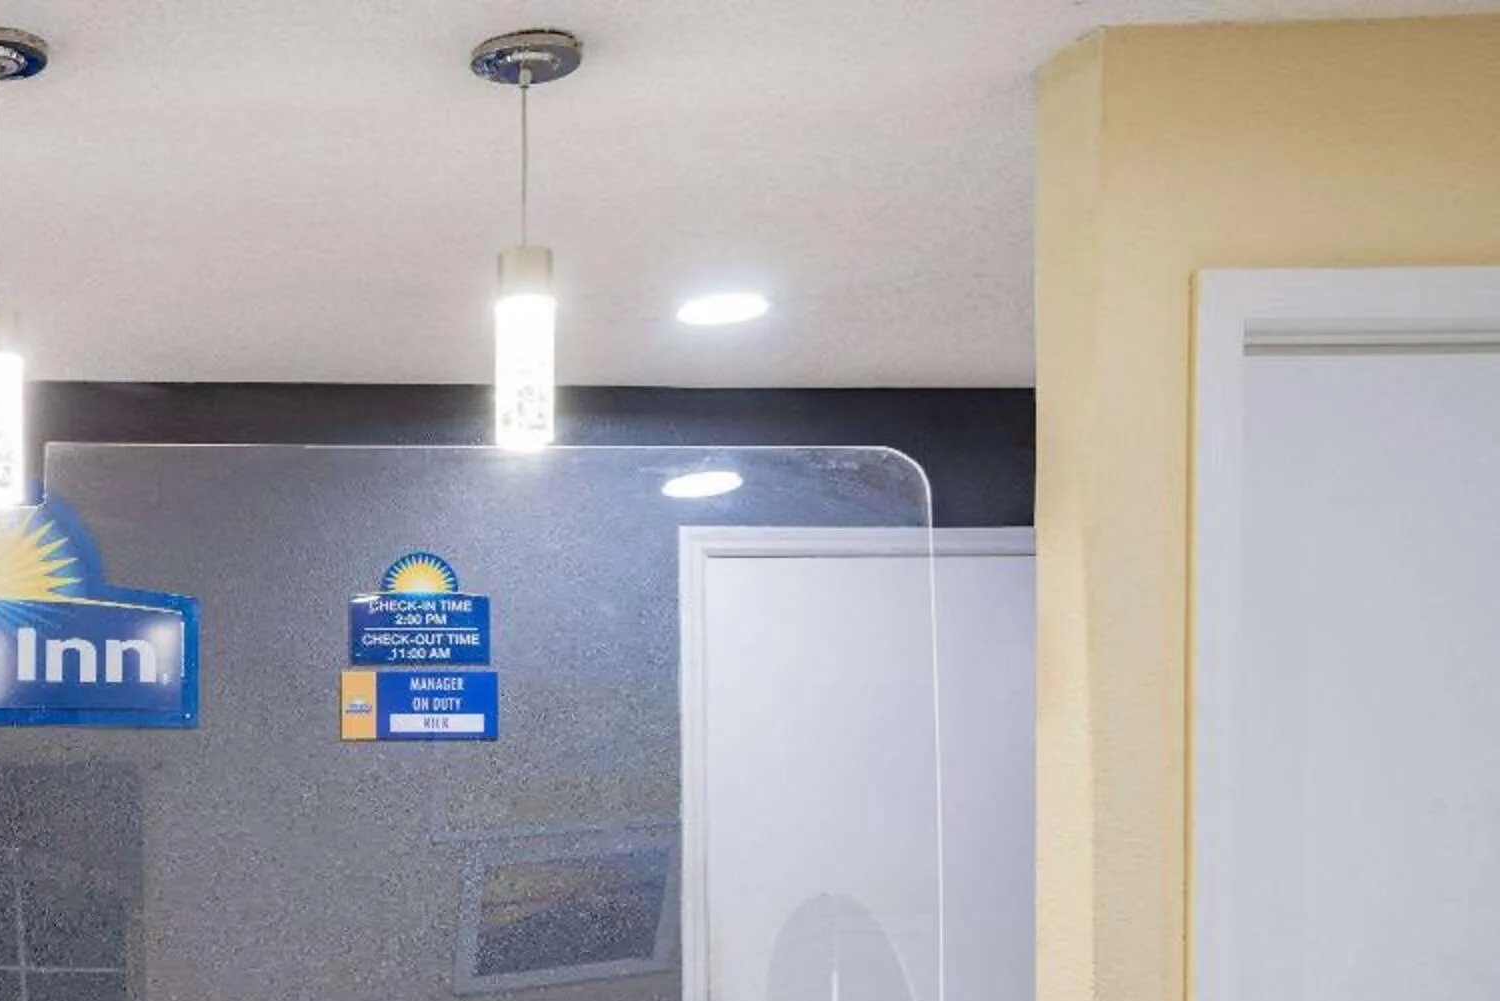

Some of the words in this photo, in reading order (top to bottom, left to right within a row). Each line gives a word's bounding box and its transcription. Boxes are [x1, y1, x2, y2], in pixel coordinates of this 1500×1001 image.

[369, 599, 436, 611] CHECK-IN
[441, 599, 473, 612] TIME
[394, 613, 422, 625] 2:00
[425, 613, 447, 625] PM
[361, 633, 444, 646] CHECK-OUT
[445, 633, 480, 645] TIME
[17, 626, 157, 684] Inn
[428, 647, 451, 659] AM
[409, 677, 465, 691] MANAGER
[412, 697, 430, 711] ON
[432, 697, 462, 712] DUTY
